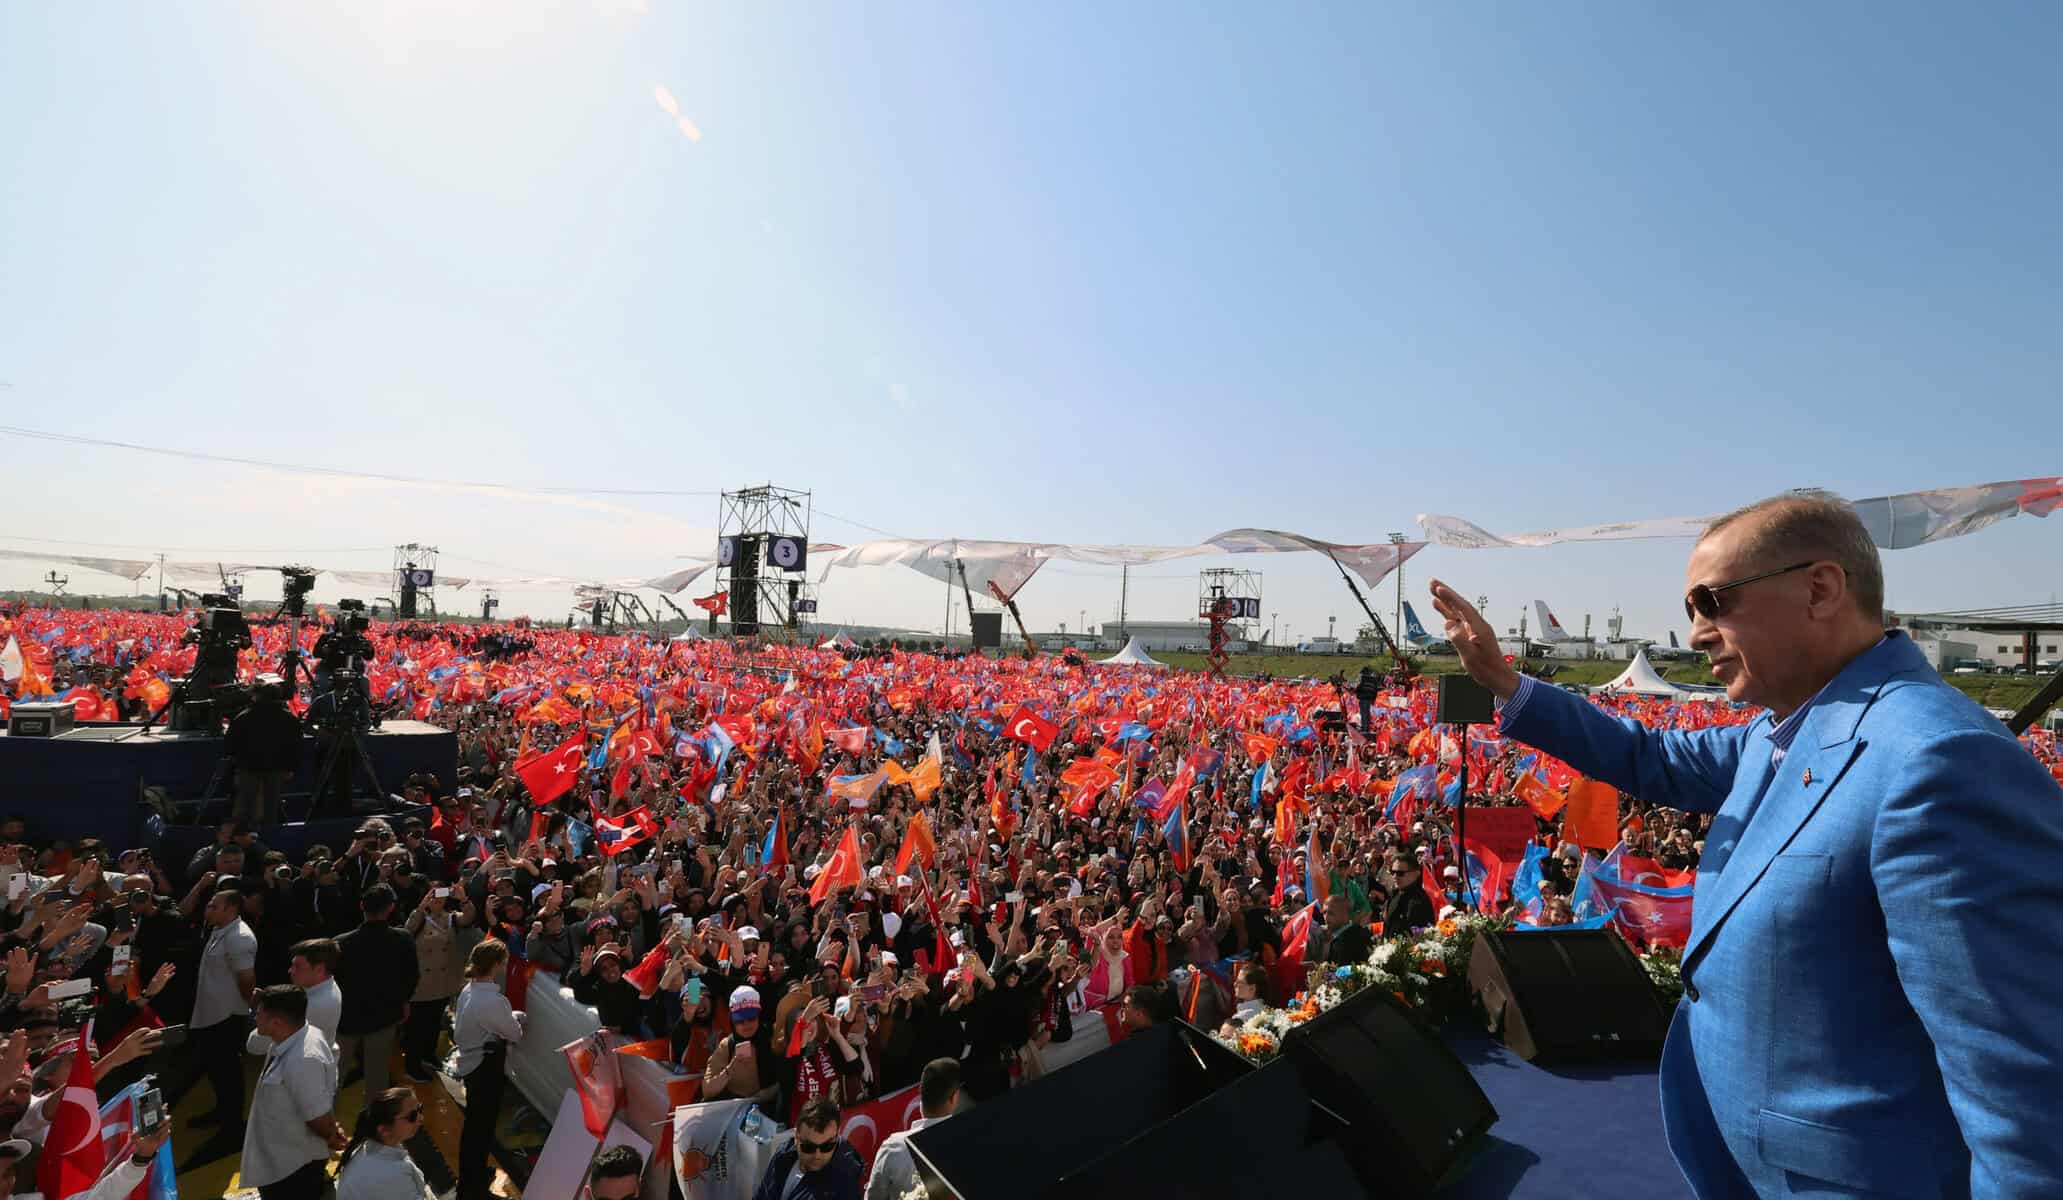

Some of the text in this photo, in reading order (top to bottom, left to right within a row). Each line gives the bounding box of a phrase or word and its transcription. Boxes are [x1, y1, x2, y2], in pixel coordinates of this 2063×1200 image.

[782, 545, 791, 559] 3
[417, 574, 424, 582] 7
[1408, 623, 1422, 634] XL
